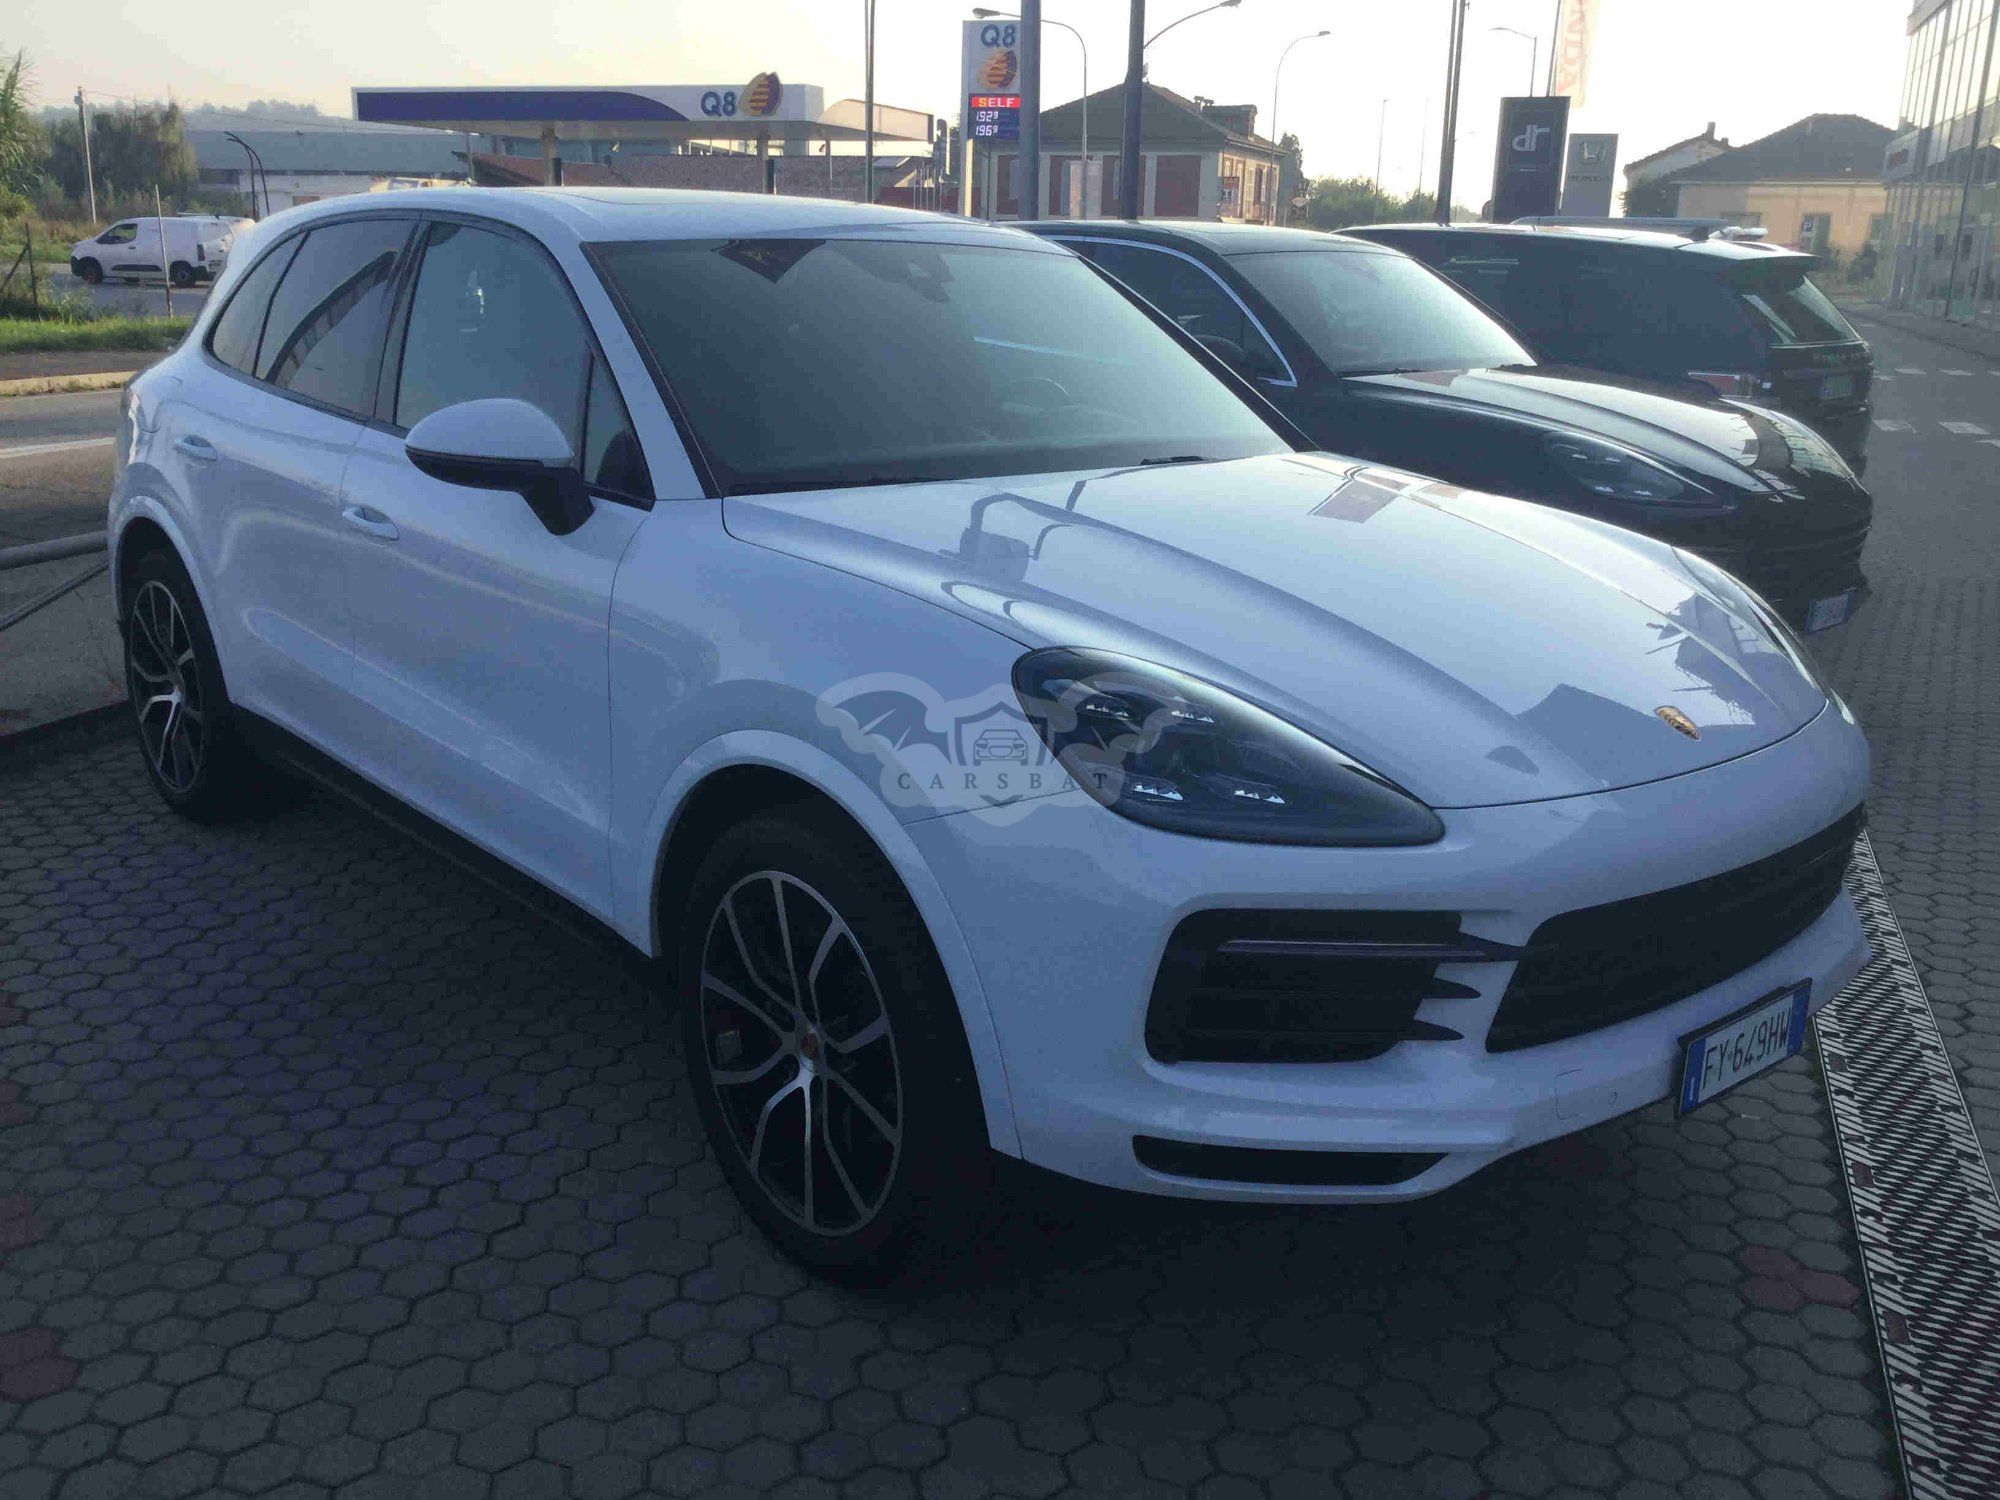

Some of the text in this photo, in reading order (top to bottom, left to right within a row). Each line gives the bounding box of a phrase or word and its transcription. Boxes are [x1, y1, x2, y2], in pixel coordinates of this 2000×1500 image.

[980, 24, 1016, 48] Q8
[701, 91, 736, 117] Q8
[978, 97, 1016, 108] SELF
